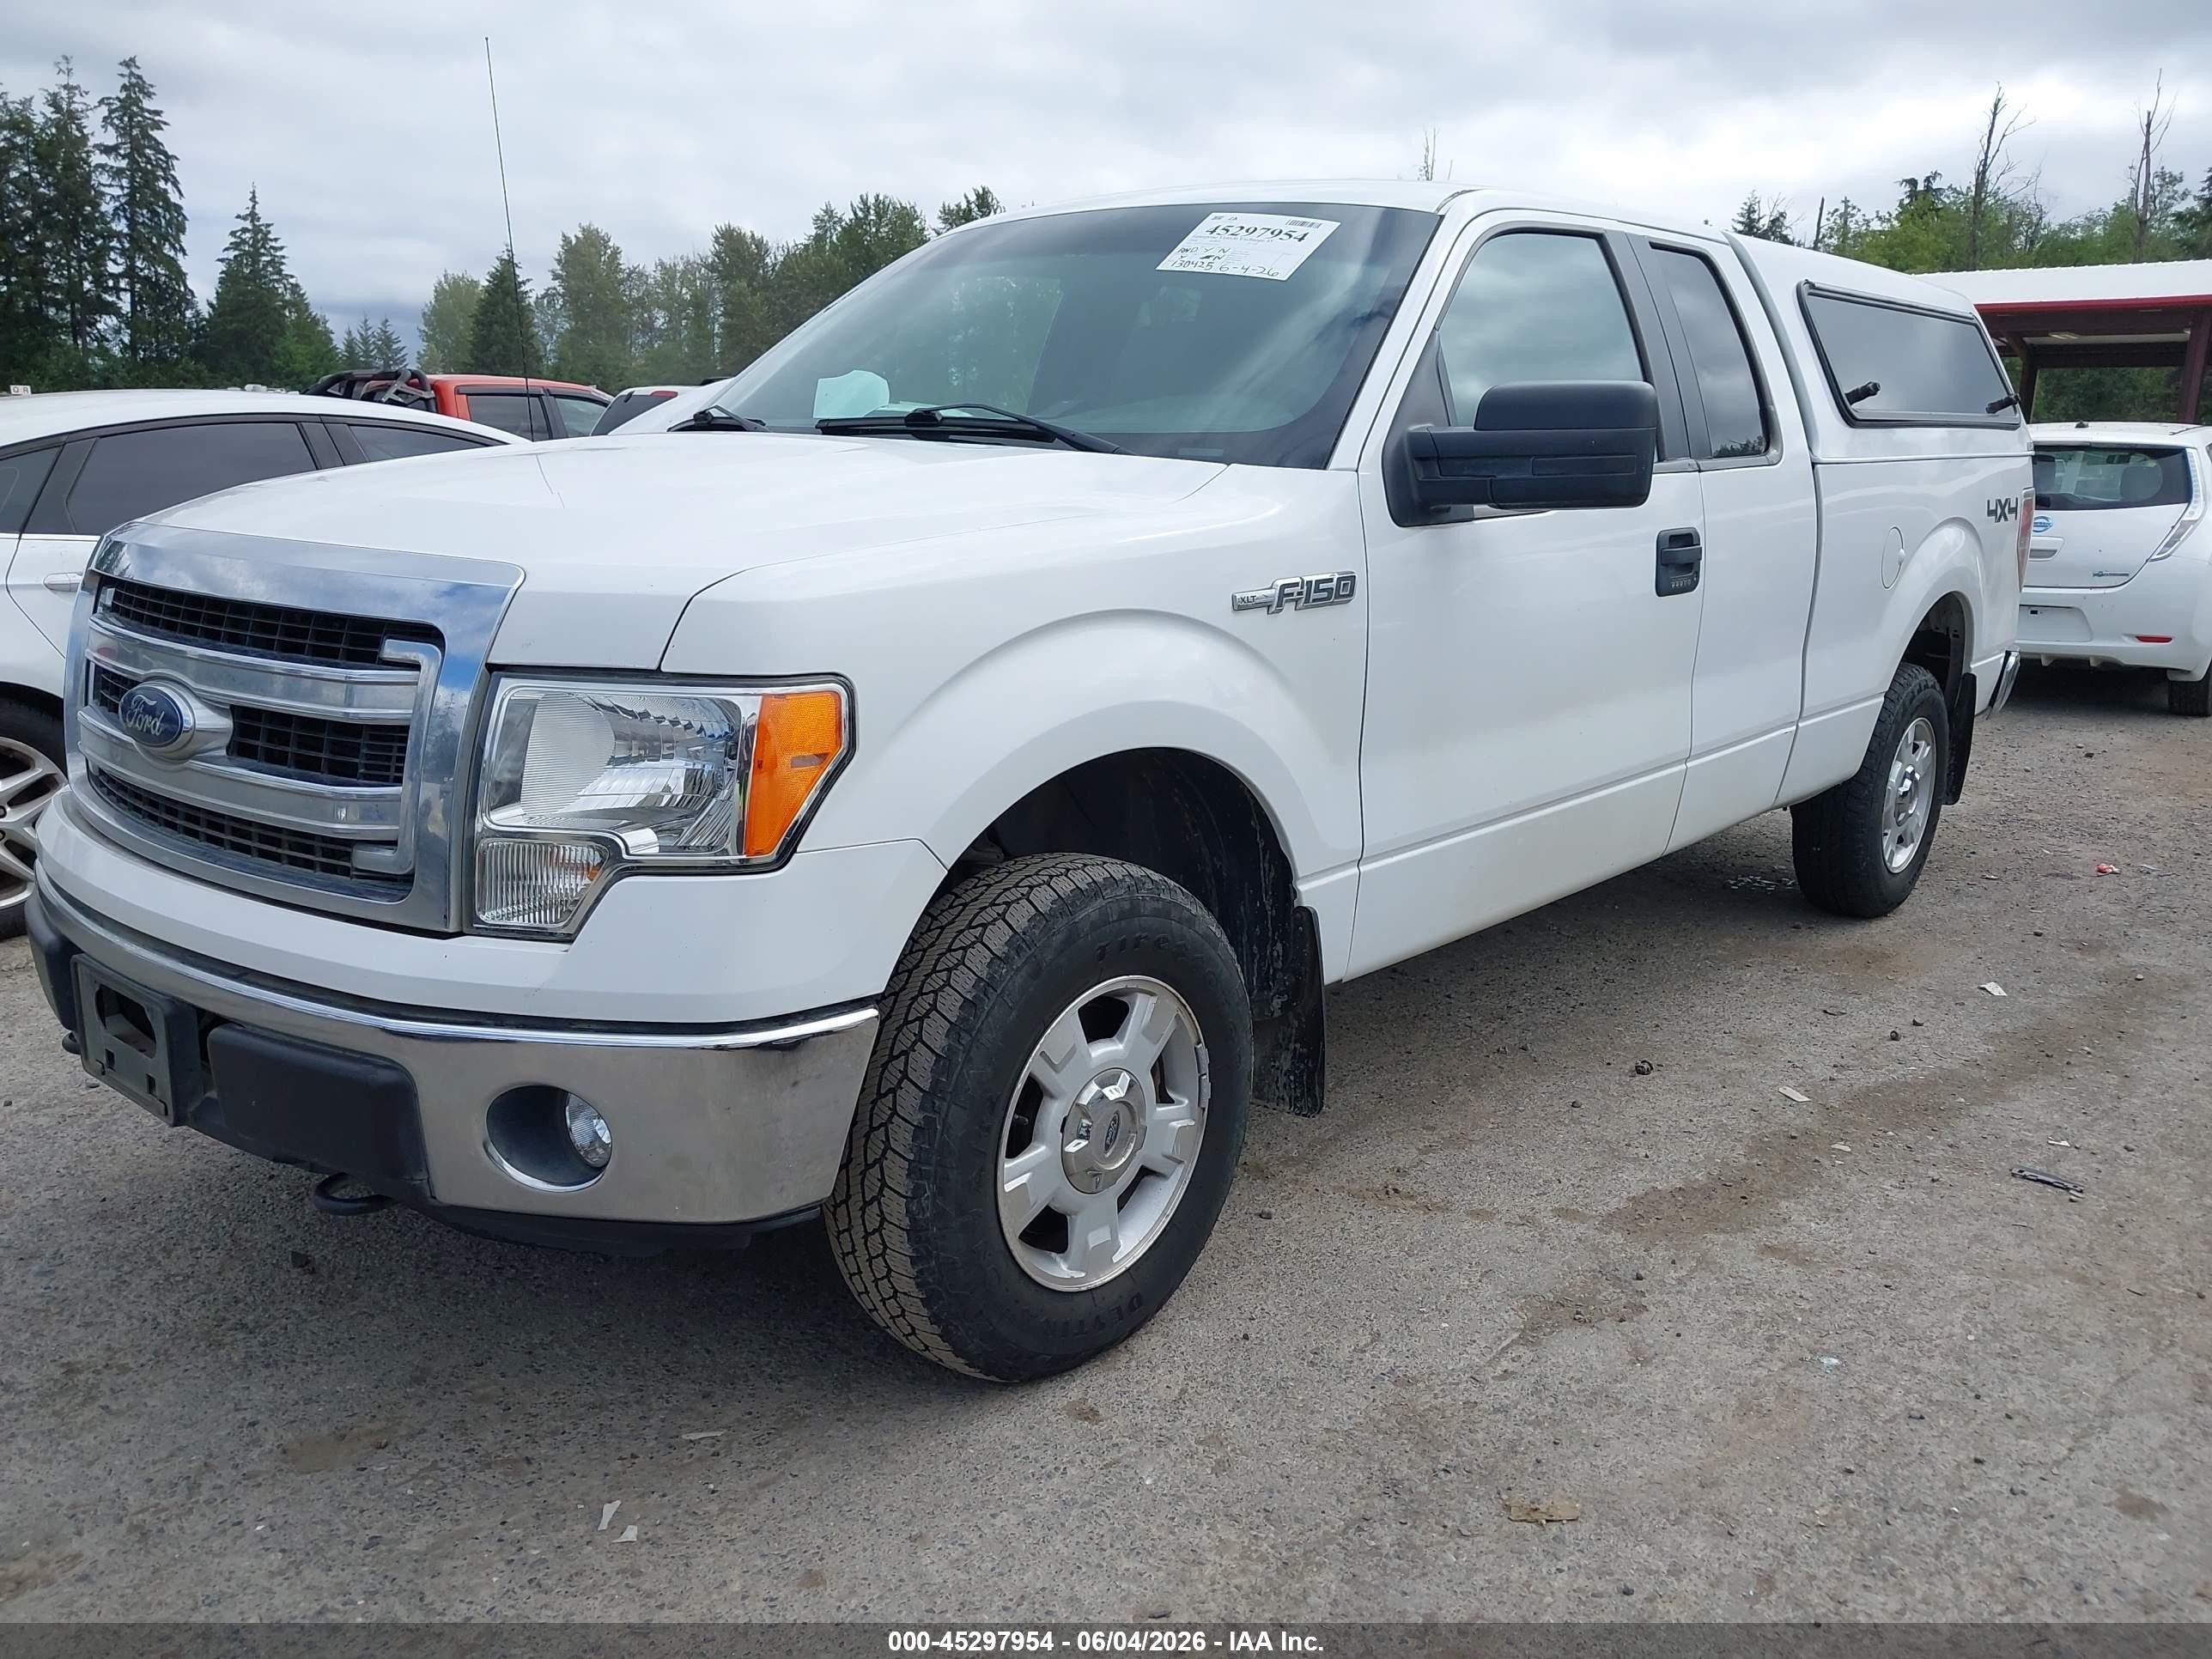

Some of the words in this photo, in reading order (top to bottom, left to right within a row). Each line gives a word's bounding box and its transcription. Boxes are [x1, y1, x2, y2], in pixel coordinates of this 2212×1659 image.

[1206, 225, 1310, 242] 45297954
[1170, 259, 1215, 270] 130425
[1219, 264, 1279, 276] 6-4-26
[1240, 595, 1256, 604] XLT
[126, 694, 165, 736] Ford
